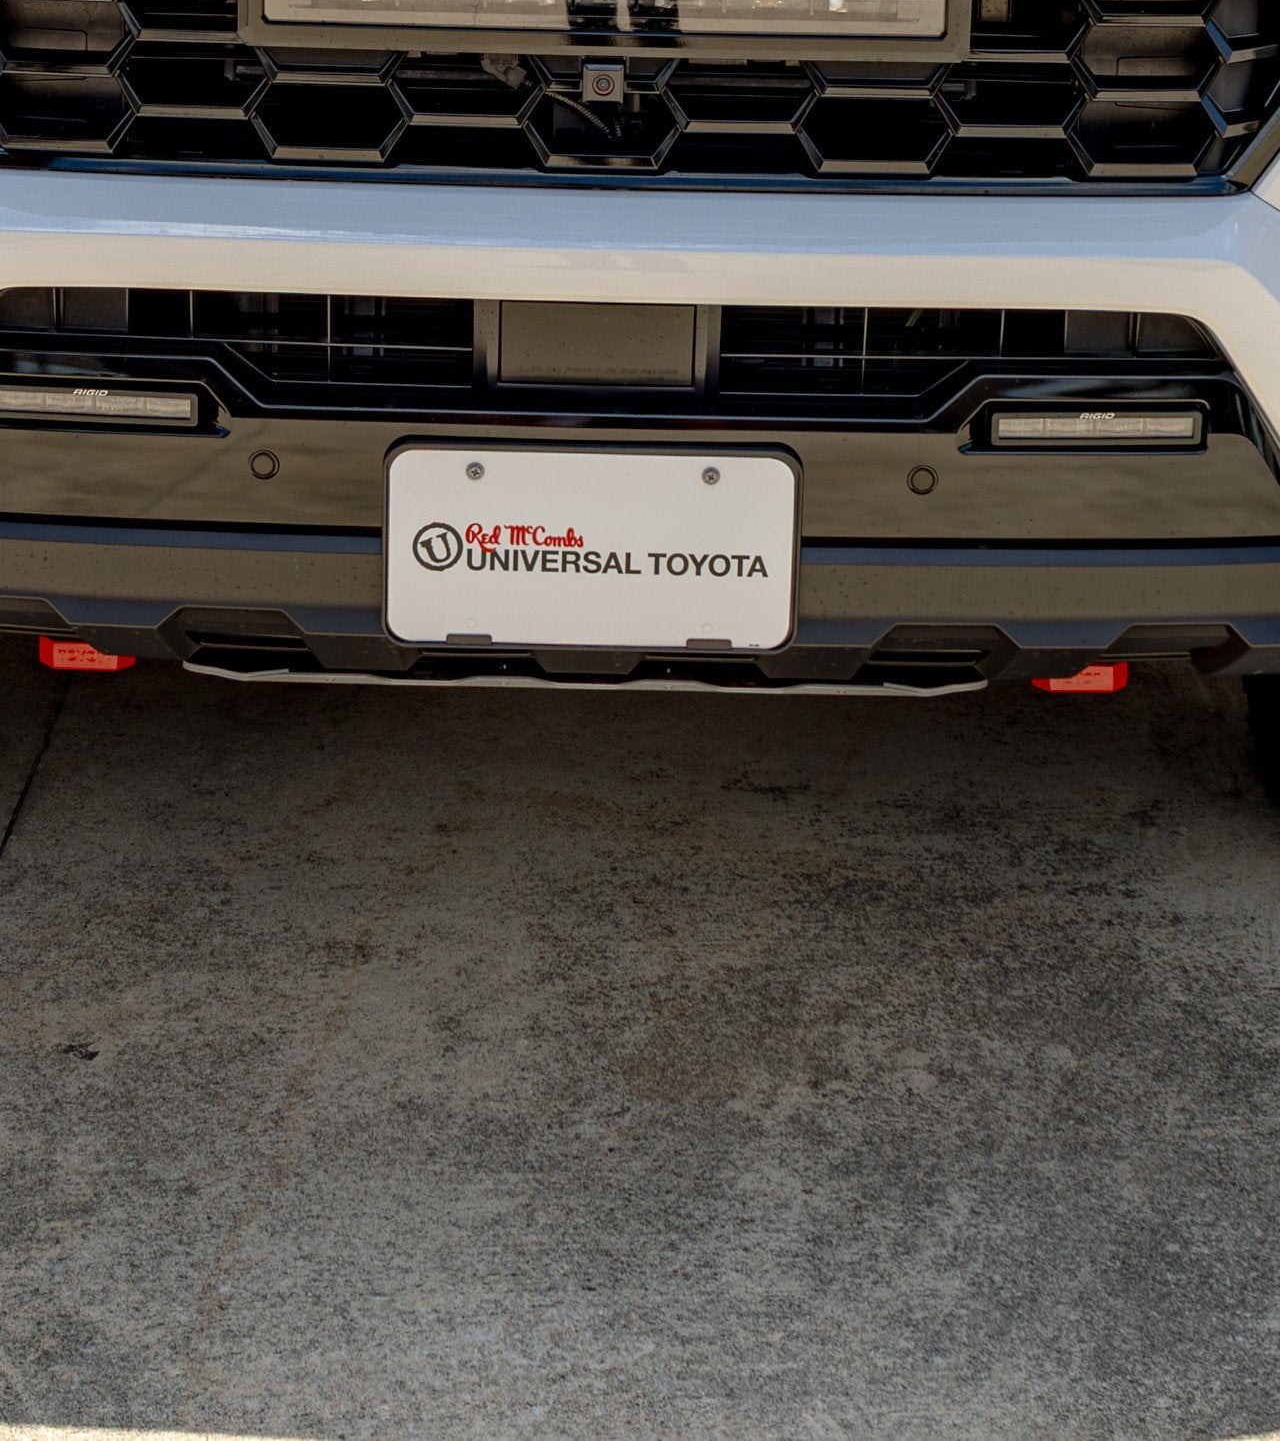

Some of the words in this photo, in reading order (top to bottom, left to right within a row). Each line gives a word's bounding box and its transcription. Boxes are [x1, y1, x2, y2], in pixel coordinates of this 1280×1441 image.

[72, 388, 109, 396] RIGID
[1079, 412, 1116, 420] RIGID
[465, 522, 501, 553] Red
[503, 524, 585, 549] McCombs
[465, 548, 642, 576] UNIVERSAL
[647, 552, 769, 578] TOYOTA
